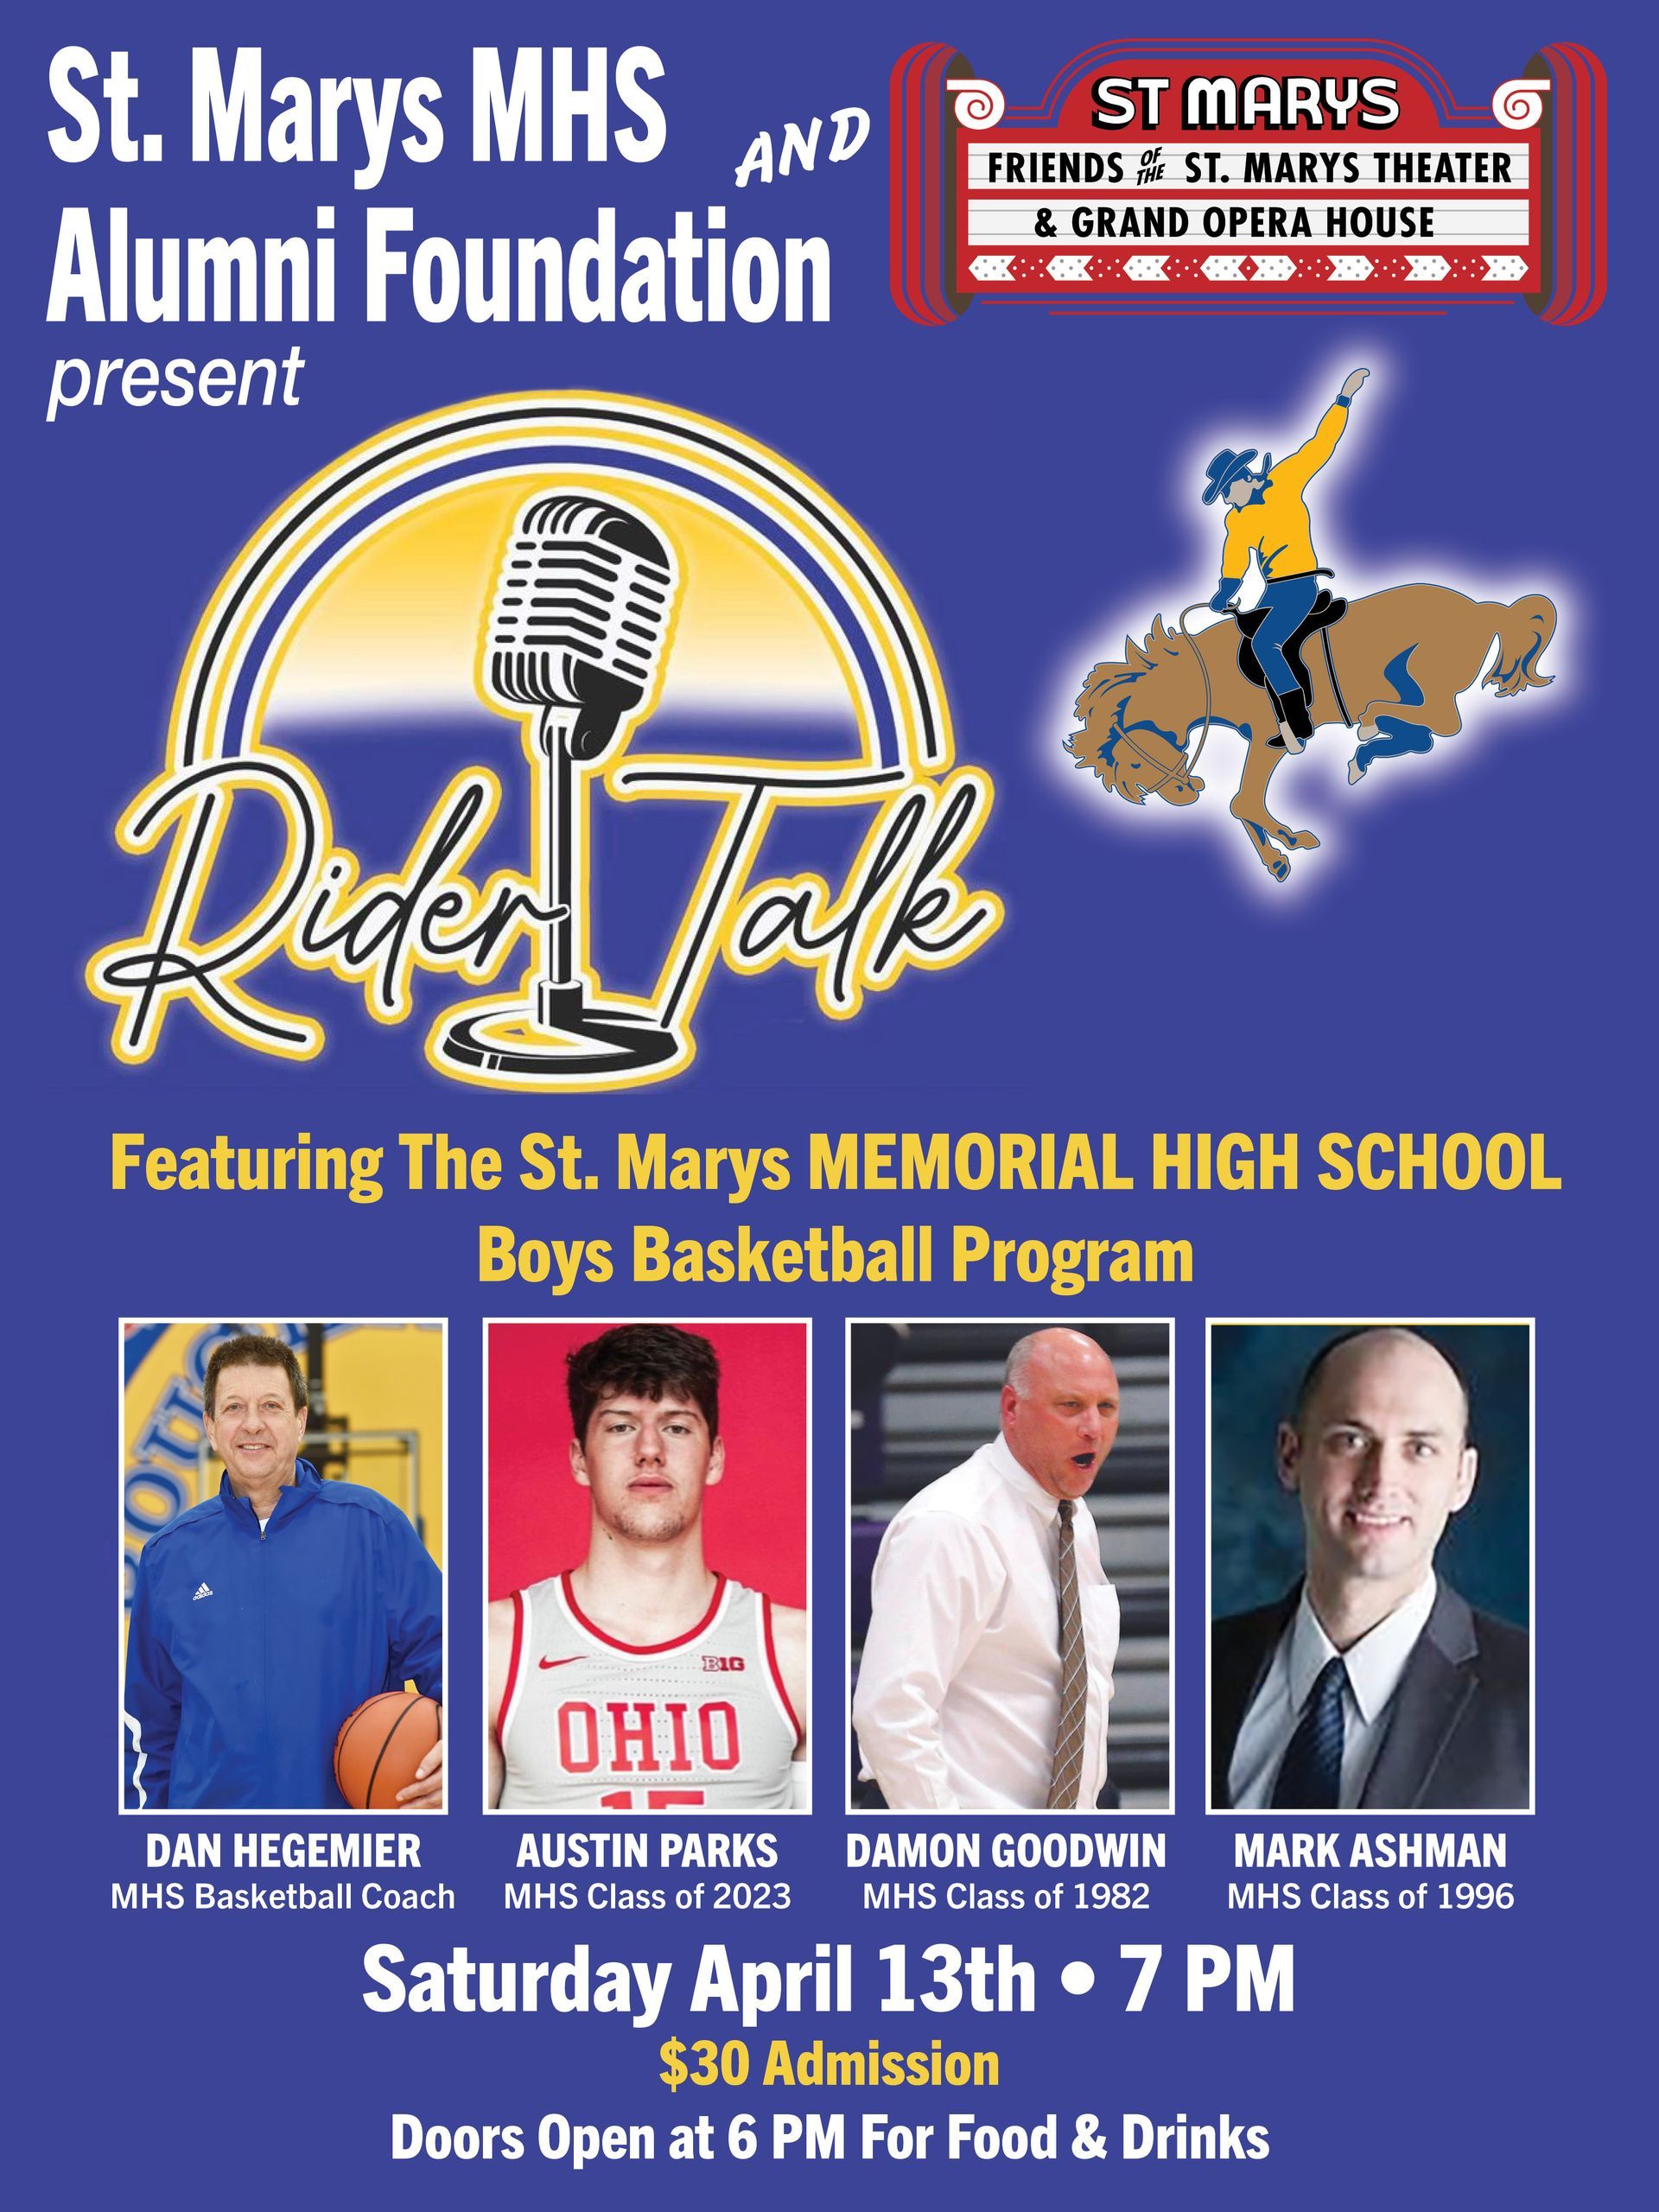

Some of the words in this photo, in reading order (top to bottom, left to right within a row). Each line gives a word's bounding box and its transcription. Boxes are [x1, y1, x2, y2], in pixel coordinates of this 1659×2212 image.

[48, 46, 162, 162] St.
[193, 48, 443, 189] Marys
[474, 46, 666, 162] MHS
[1092, 76, 1169, 130] ST
[1181, 76, 1401, 130] MARYS
[735, 107, 869, 187] AND
[1141, 147, 1162, 167] OF
[989, 152, 1123, 182] FRIENDS
[1136, 163, 1166, 186] THE
[1185, 152, 1229, 182] ST.
[1244, 152, 1358, 182] MARYS
[1374, 153, 1511, 182] THEATER
[1035, 208, 1057, 237] &
[1072, 207, 1188, 237] GRAND
[1204, 207, 1312, 237] OPERA
[1327, 207, 1433, 237] HOUSE
[46, 207, 334, 322] Alumni
[367, 207, 830, 322] Foundation
[46, 346, 305, 422] present
[101, 760, 570, 1048] Rider
[620, 768, 988, 1030] Talk
[112, 1133, 383, 1203] Featuring
[399, 1134, 501, 1190] The
[520, 1133, 598, 1190] St.
[619, 1134, 790, 1203] Marys
[810, 1133, 1134, 1190] MEMORIAL
[1154, 1133, 1297, 1190] HIGH
[1319, 1133, 1561, 1190] SCHOOL
[480, 1226, 613, 1295] Boys
[634, 1226, 931, 1282] Basketball
[954, 1225, 1192, 1295] Program
[192, 1590, 213, 1601] adidas
[557, 1700, 741, 1775] OHIO
[148, 1834, 220, 1867] DAN
[234, 1834, 421, 1867] HEGEMIER
[517, 1834, 647, 1867] AUSTIN
[661, 1834, 778, 1867] PARKS
[848, 1834, 979, 1867] DAMON
[992, 1834, 1165, 1867] GOODWIN
[1236, 1834, 1340, 1867] MARK
[1350, 1834, 1506, 1867] ASHMAN
[112, 1883, 184, 1910] MHS
[196, 1884, 351, 1909] Basketball
[362, 1883, 454, 1909] Coach
[505, 1883, 577, 1910] MHS
[588, 1883, 665, 1909] Class
[676, 1883, 704, 1909] of
[714, 1883, 791, 1909] 2023
[864, 1883, 936, 1909] MHS
[947, 1883, 1025, 1909] Class
[1035, 1883, 1064, 1909] of
[1075, 1883, 1149, 1909] 1982
[1229, 1883, 1300, 1909] MHS
[1311, 1883, 1389, 1909] Class
[1399, 1883, 1427, 1909] of
[1439, 1883, 1514, 1909] 1996
[363, 1944, 672, 2028] Saturday
[690, 1943, 851, 2027] April
[880, 1944, 1034, 2012] 13th
[1121, 1945, 1161, 2012] 7
[1187, 1945, 1294, 2012] PM
[660, 2037, 749, 2092] $30
[763, 2040, 998, 2086] Admission
[392, 2114, 524, 2159] Doors
[538, 2113, 654, 2169] Open
[670, 2116, 714, 2159] at
[728, 2113, 757, 2159] 6
[773, 2114, 844, 2158] PM
[862, 2114, 933, 2159] For
[950, 2114, 1057, 2159] Food
[1071, 2113, 1107, 2159] &
[1123, 2113, 1269, 2159] Drinks
